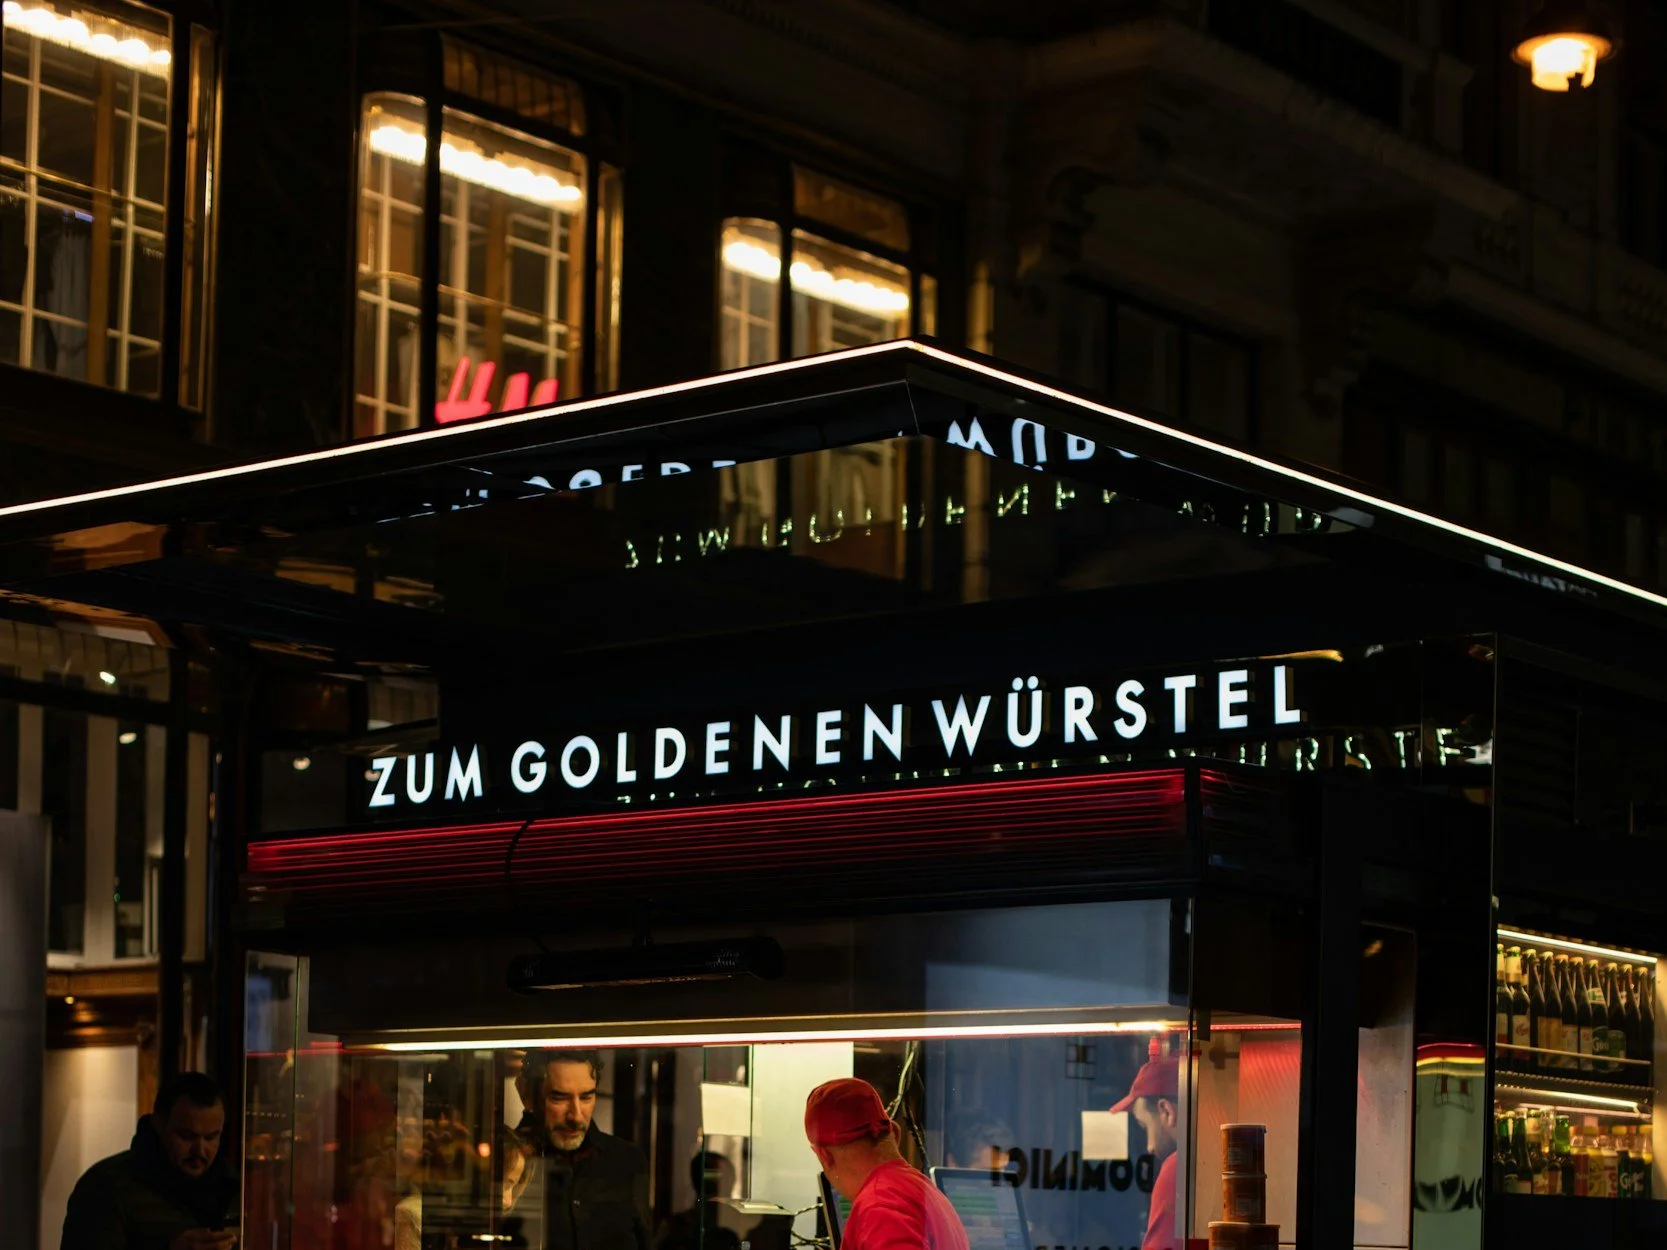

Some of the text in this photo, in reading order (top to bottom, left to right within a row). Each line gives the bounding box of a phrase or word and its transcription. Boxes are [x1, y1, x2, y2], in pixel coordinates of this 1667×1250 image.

[367, 664, 1304, 808] ZUM GOLDENEN WÜRSTEL
